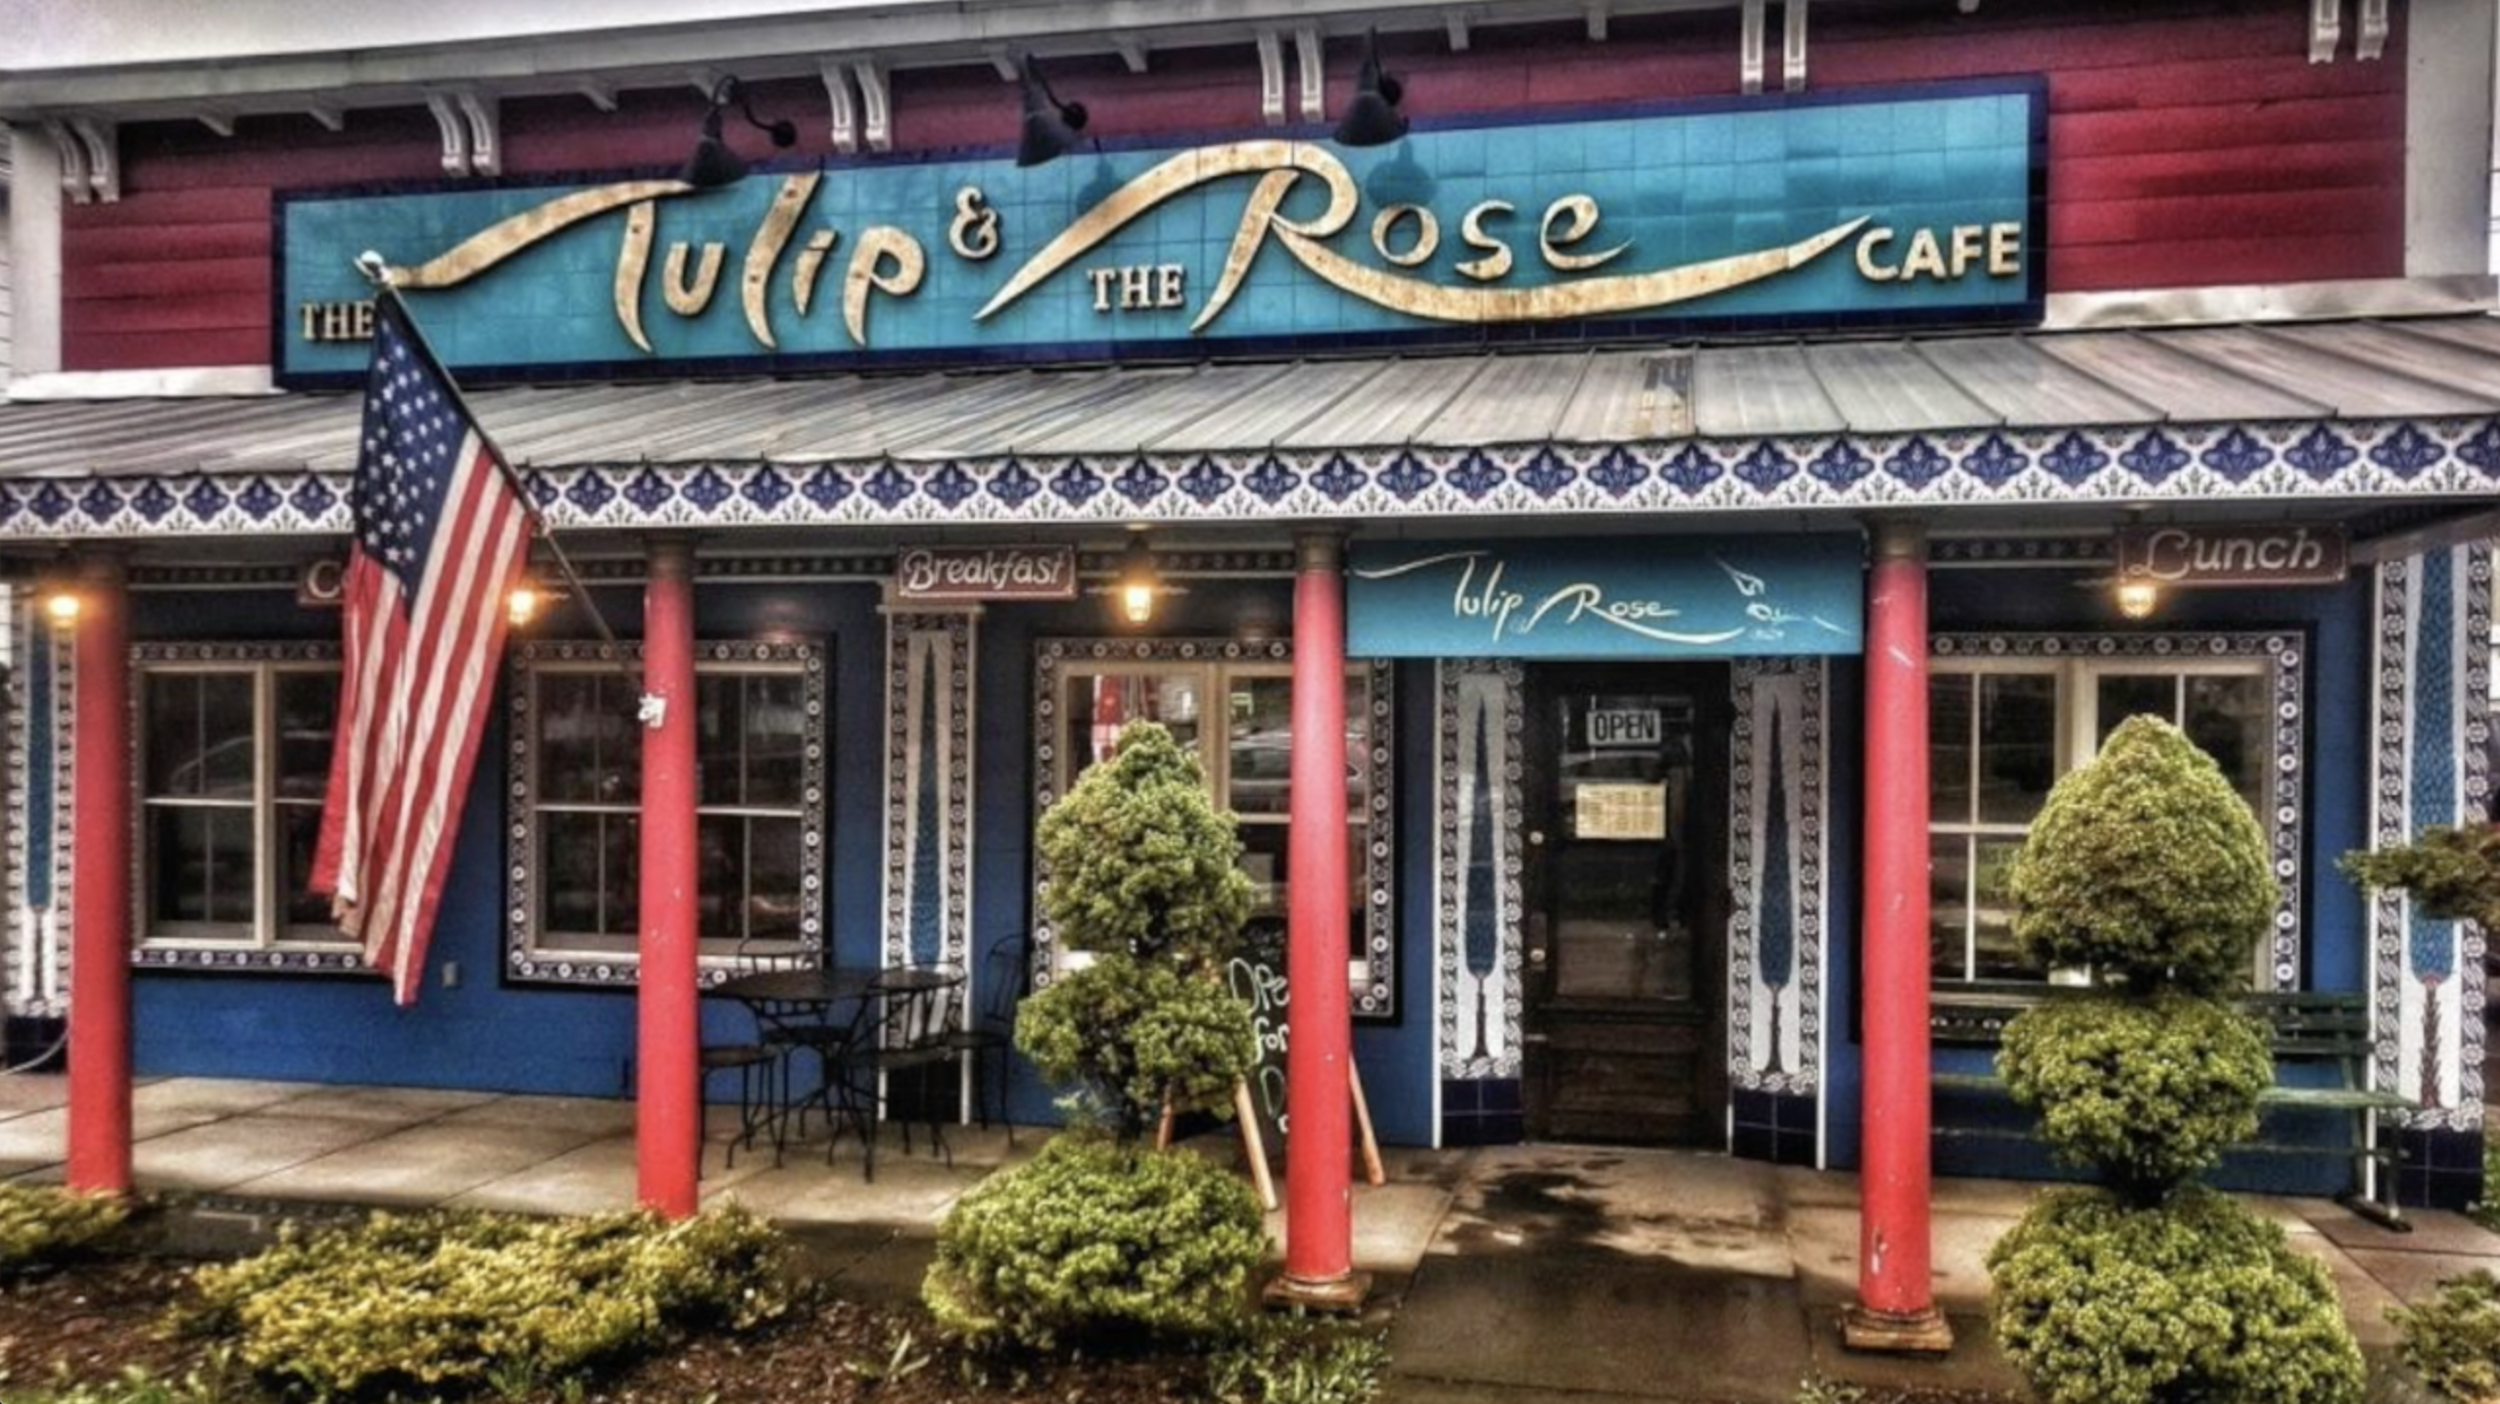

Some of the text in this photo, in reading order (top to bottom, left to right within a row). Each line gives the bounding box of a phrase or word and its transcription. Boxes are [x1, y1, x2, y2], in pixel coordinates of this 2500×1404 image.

[301, 138, 2023, 352] THE Tulip & THE Rose CAFE
[904, 550, 1065, 591] Breakfast
[2128, 528, 2323, 580] Lunch
[1354, 550, 1745, 644] Tulip Rose
[1594, 713, 1657, 741] OPEN
[1229, 957, 1290, 1014] Ope
